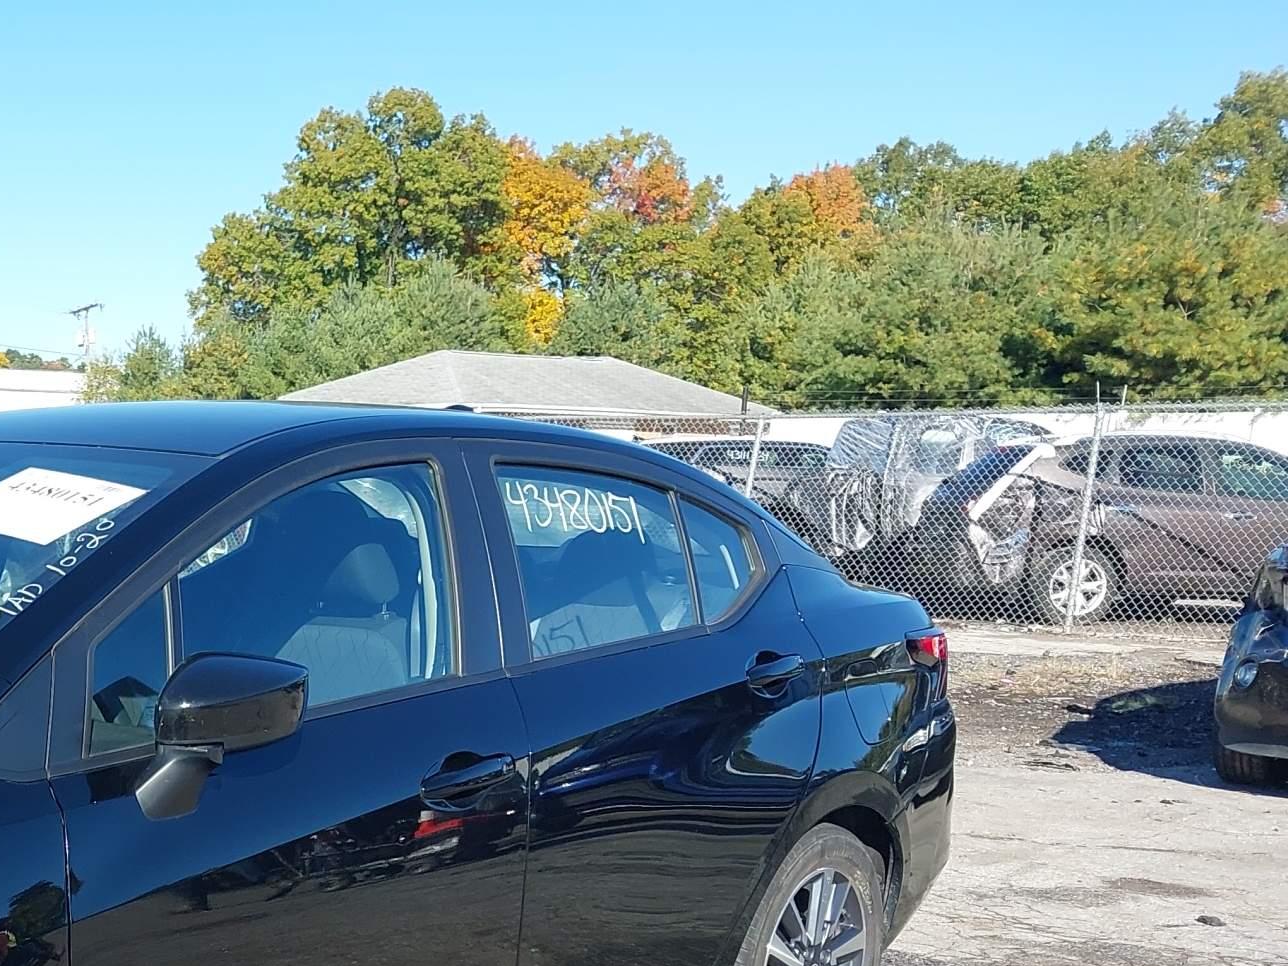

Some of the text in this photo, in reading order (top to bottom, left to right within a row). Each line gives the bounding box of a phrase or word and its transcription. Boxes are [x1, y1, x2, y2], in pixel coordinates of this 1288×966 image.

[8, 481, 105, 507] 43480151
[505, 479, 646, 545] 43480151
[45, 517, 115, 576] 10-20
